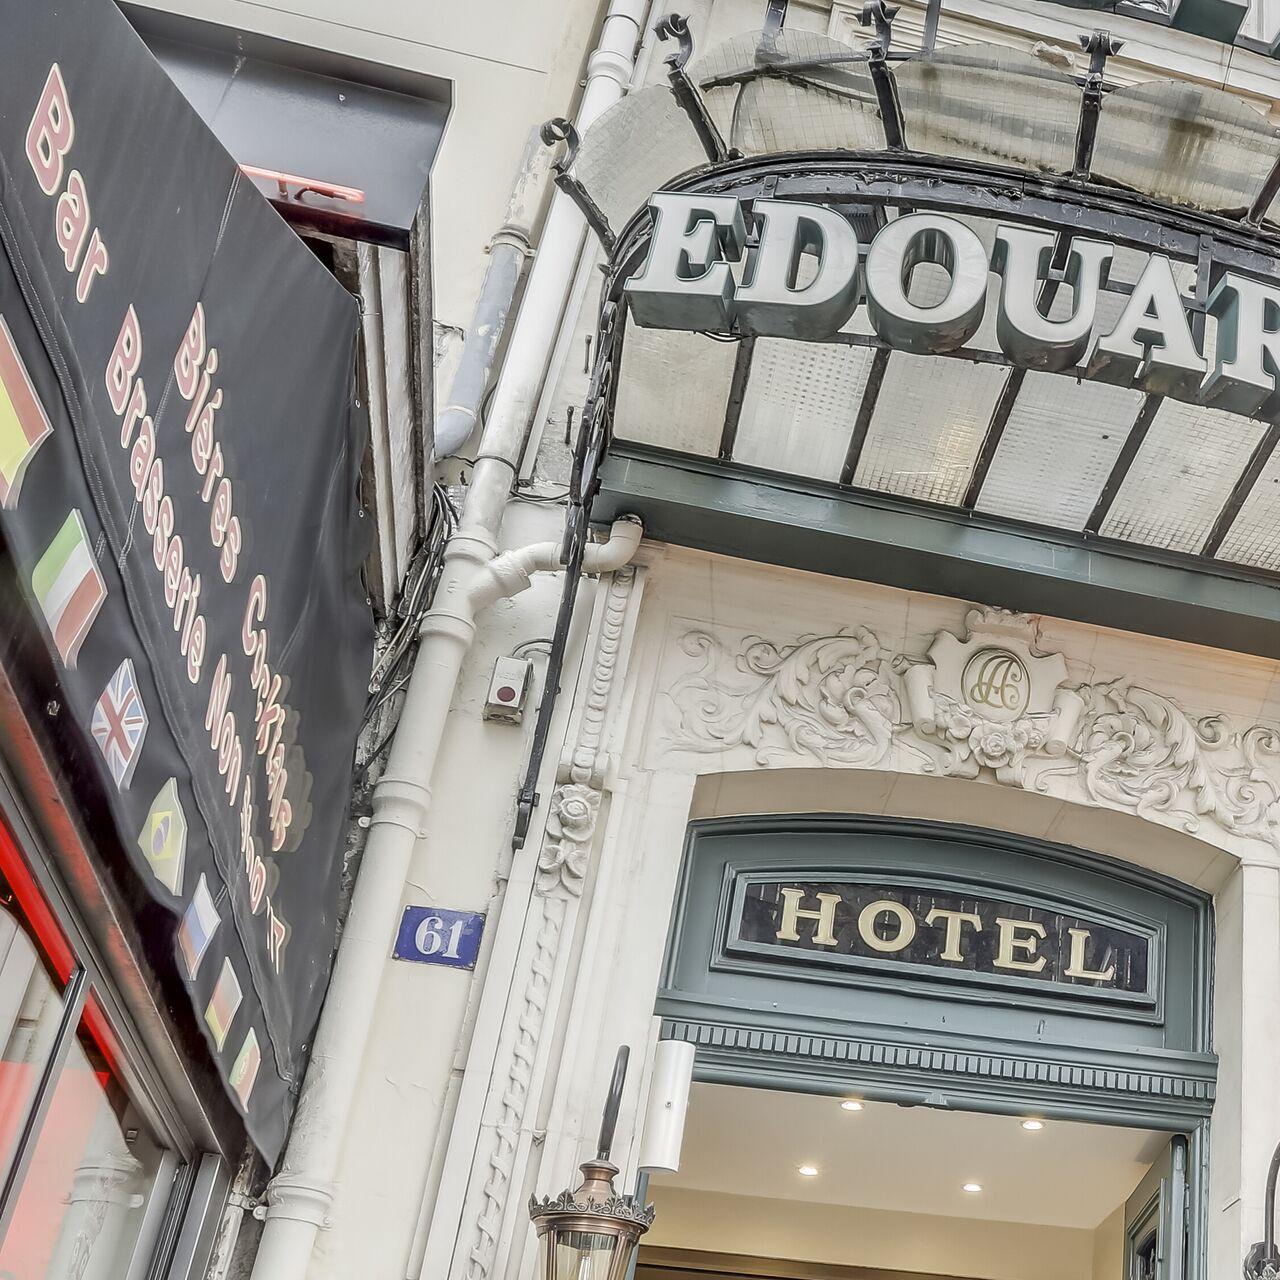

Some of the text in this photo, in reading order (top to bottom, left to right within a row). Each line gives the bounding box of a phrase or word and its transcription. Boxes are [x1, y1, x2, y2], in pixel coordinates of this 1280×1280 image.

[25, 63, 109, 304] Bar
[105, 303, 206, 684] Brasserie
[204, 653, 242, 807] Non
[415, 916, 463, 959] 61
[775, 886, 1115, 982] HOTEL
